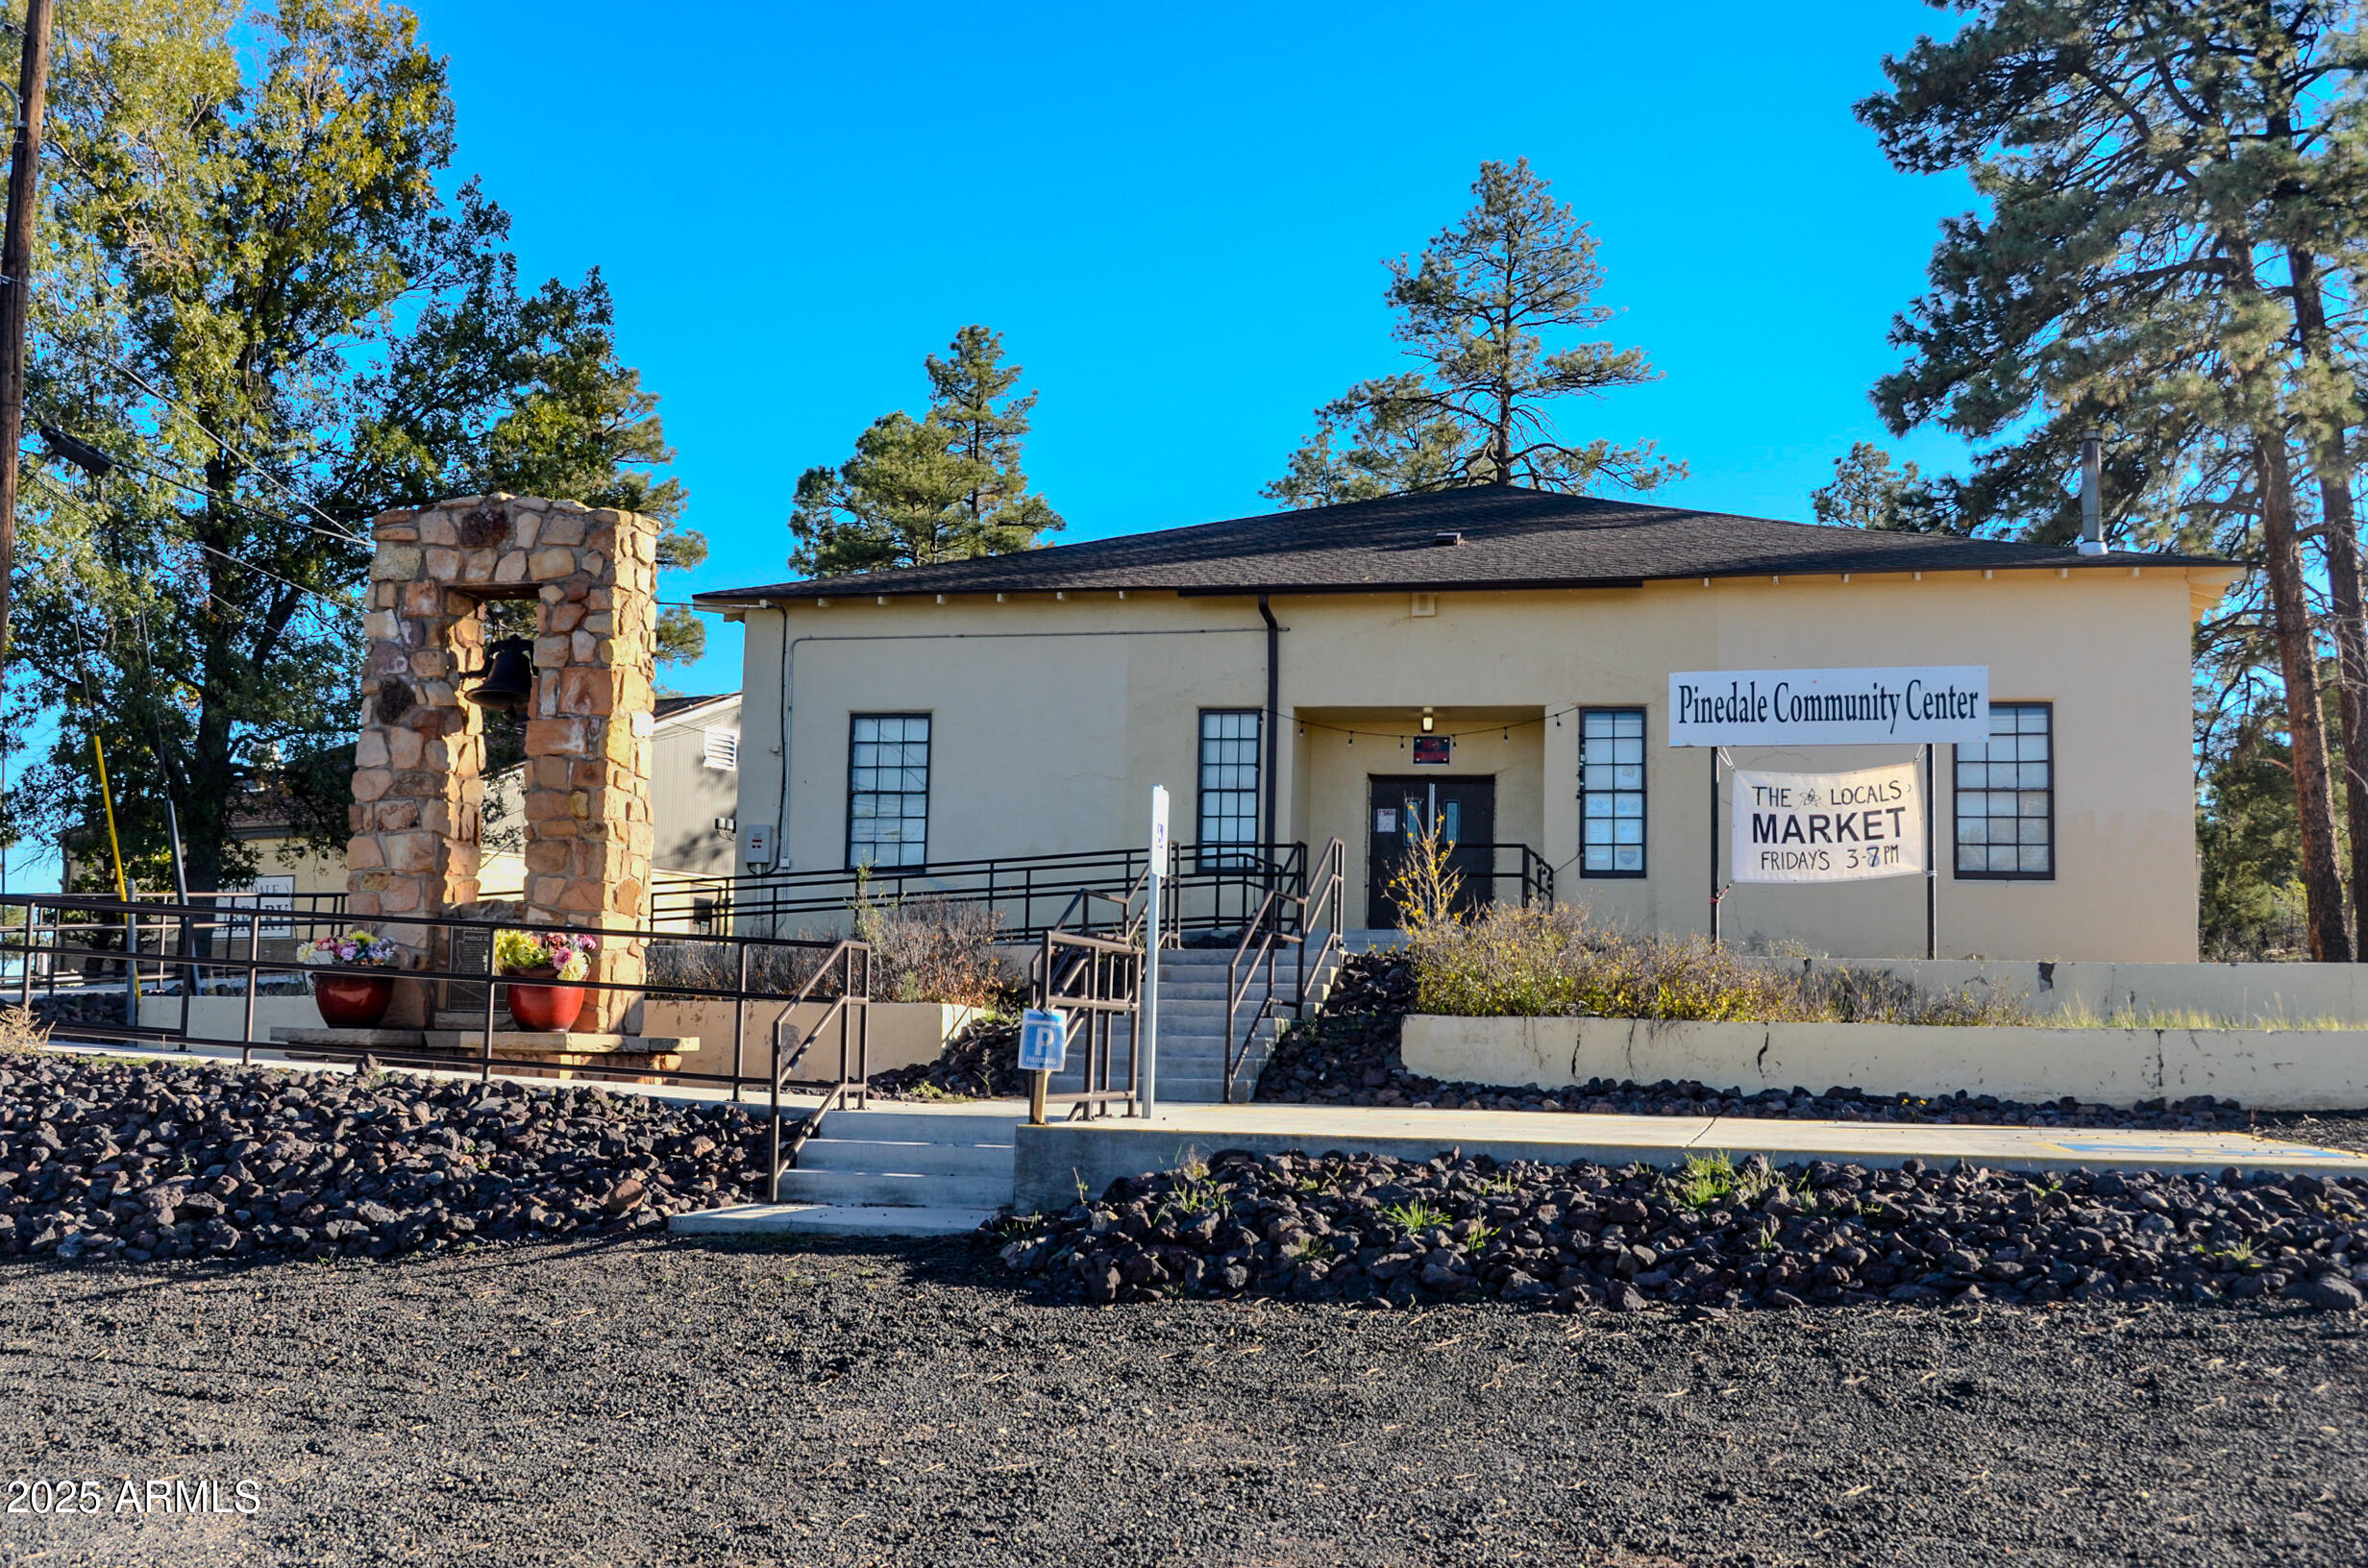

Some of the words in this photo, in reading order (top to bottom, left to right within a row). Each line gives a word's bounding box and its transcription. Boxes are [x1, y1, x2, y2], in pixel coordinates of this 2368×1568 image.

[1678, 681, 1767, 724] Pinedale
[1773, 682, 1901, 735] Community
[1906, 678, 1979, 722] Center
[1751, 786, 1791, 808] THE
[1830, 780, 1902, 806] LOCALS
[1752, 806, 1906, 845] MARKET
[1035, 1027, 1054, 1056] P
